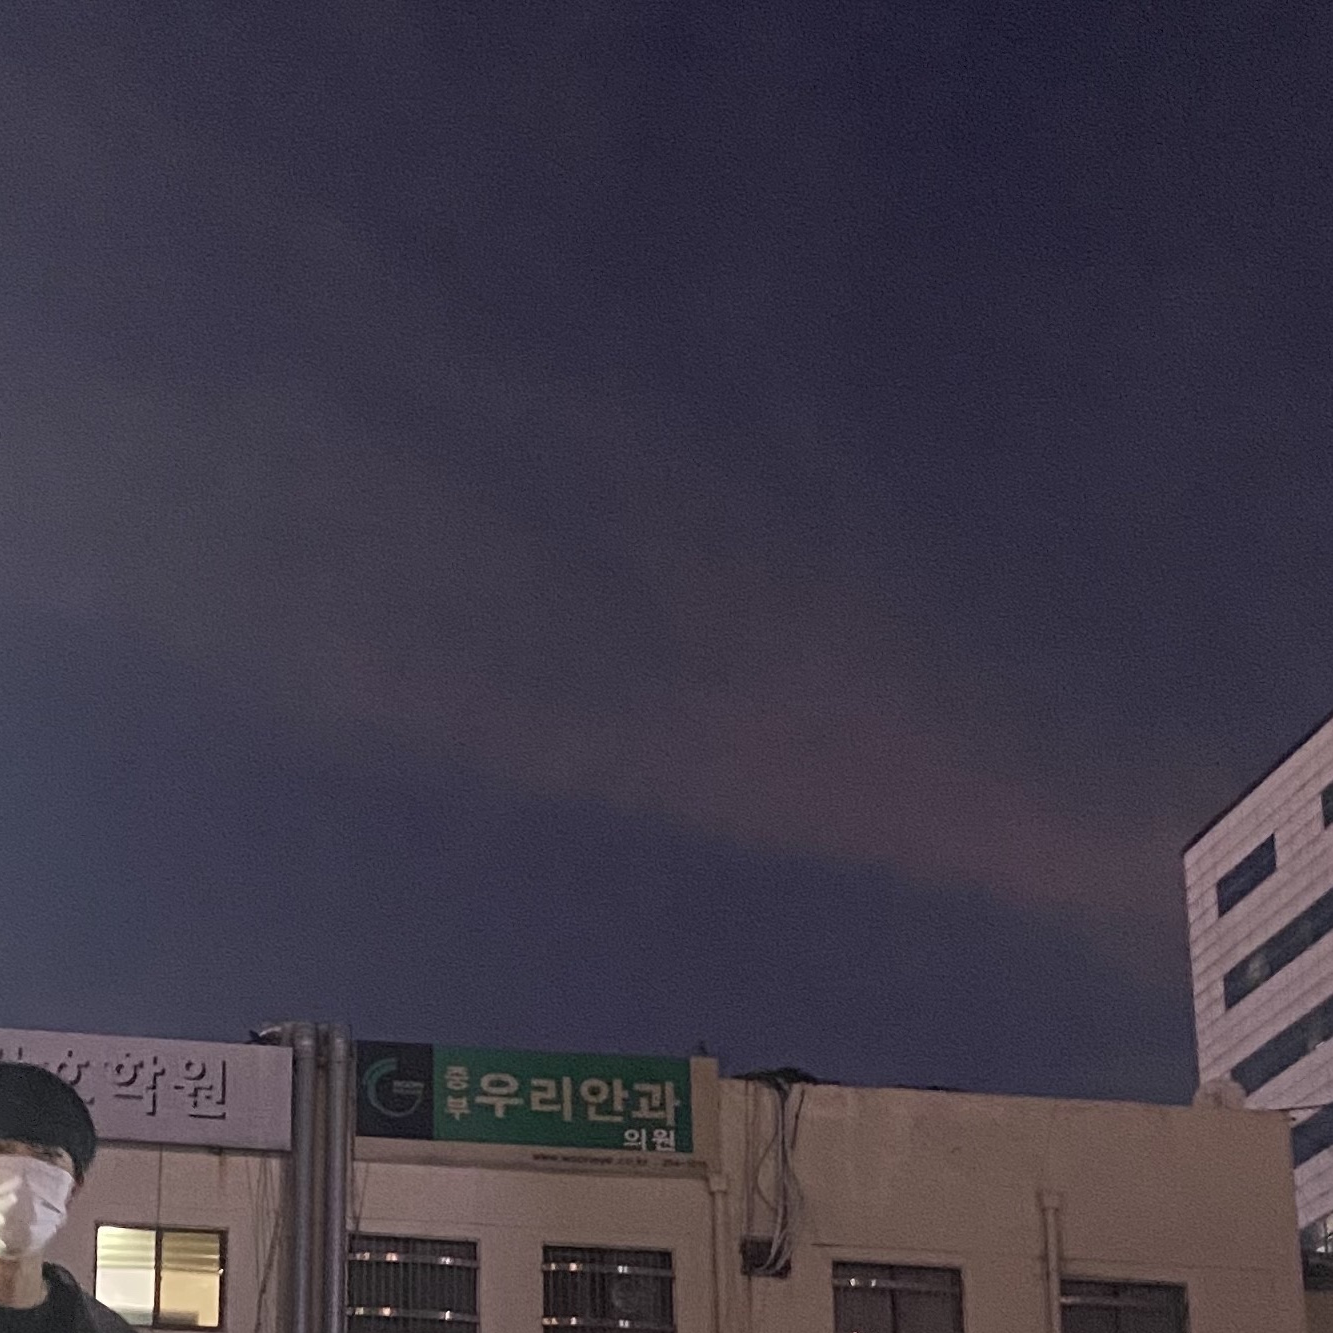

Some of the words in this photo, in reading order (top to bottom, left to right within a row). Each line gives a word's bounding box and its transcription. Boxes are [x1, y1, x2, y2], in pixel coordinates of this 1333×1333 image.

[445, 1066, 470, 1121] 중부
[474, 1073, 681, 1128] 우리안과
[624, 1128, 676, 1151] 의원
